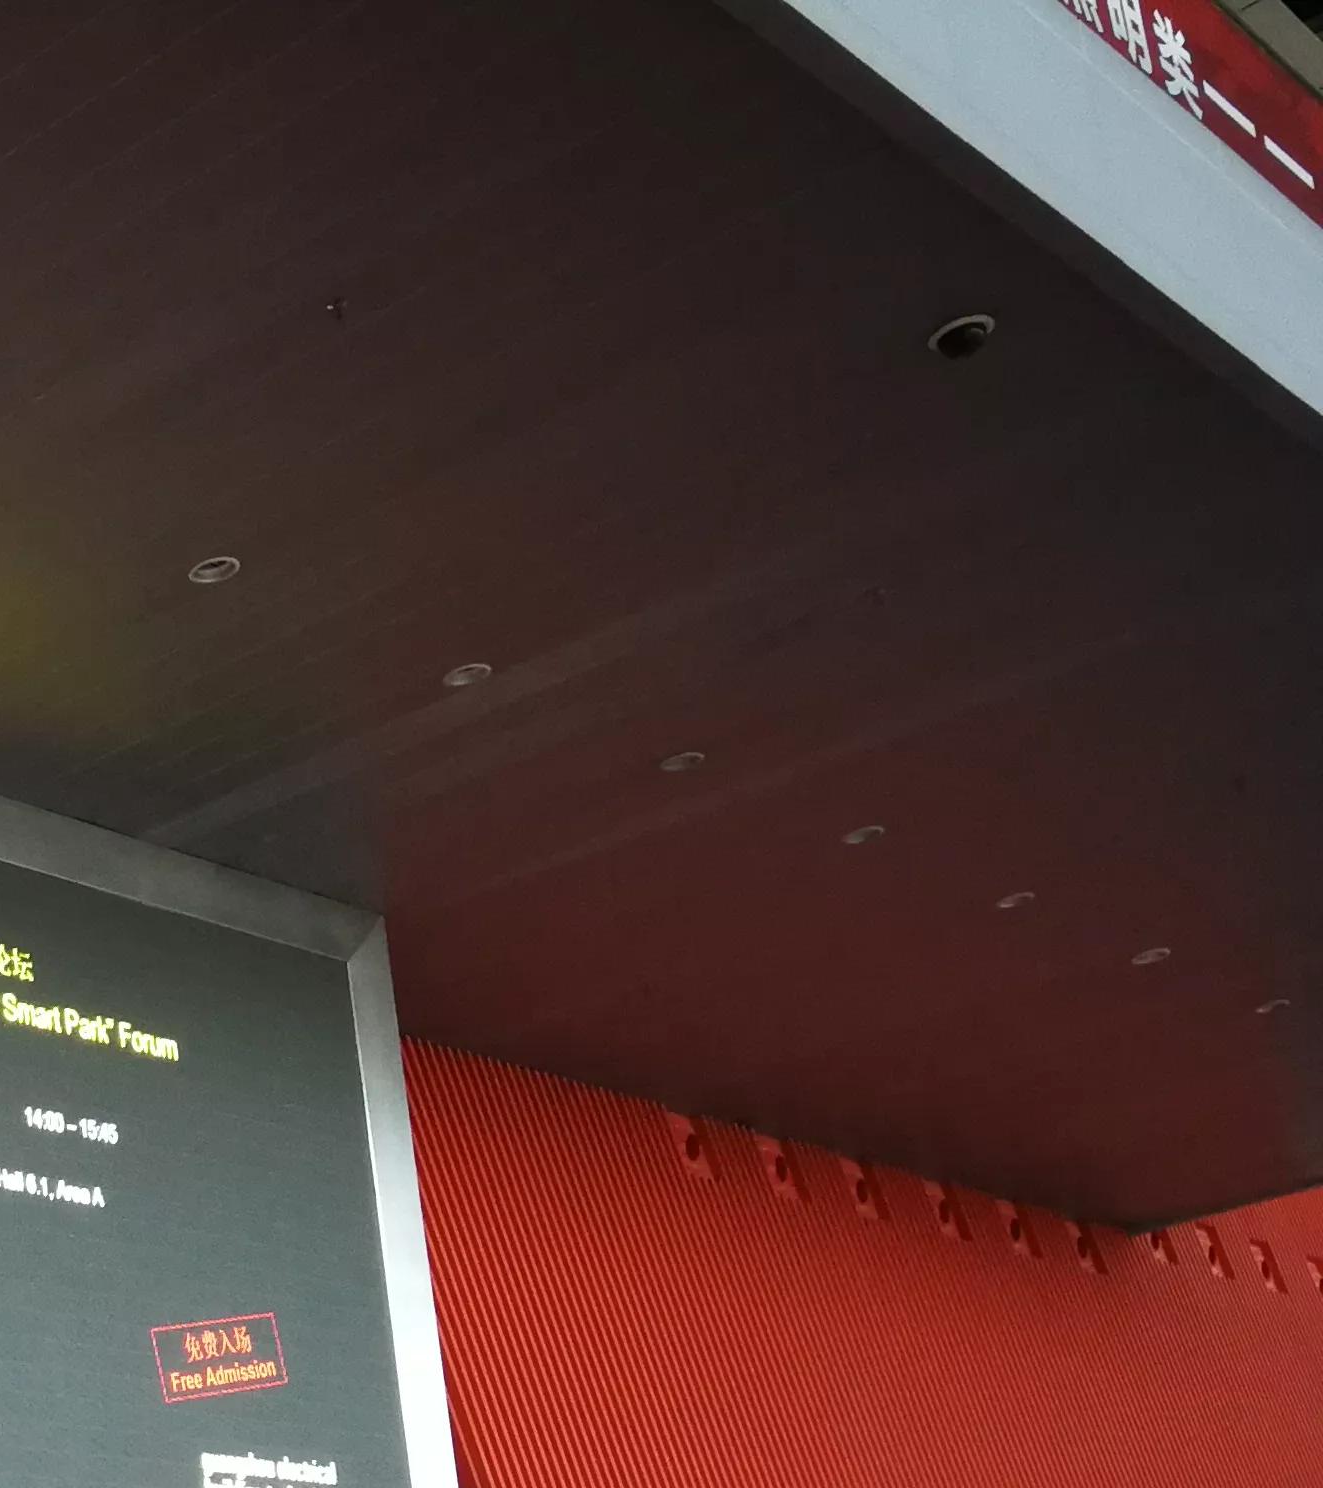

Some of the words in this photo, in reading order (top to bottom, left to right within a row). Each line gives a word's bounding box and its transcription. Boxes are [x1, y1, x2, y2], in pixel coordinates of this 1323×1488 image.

[2, 993, 62, 1033] Smart
[118, 1021, 179, 1061] Forum
[92, 1186, 105, 1208] A
[185, 1326, 252, 1363] 免费入场
[170, 1371, 203, 1393] Free
[206, 1359, 277, 1387] Admission
